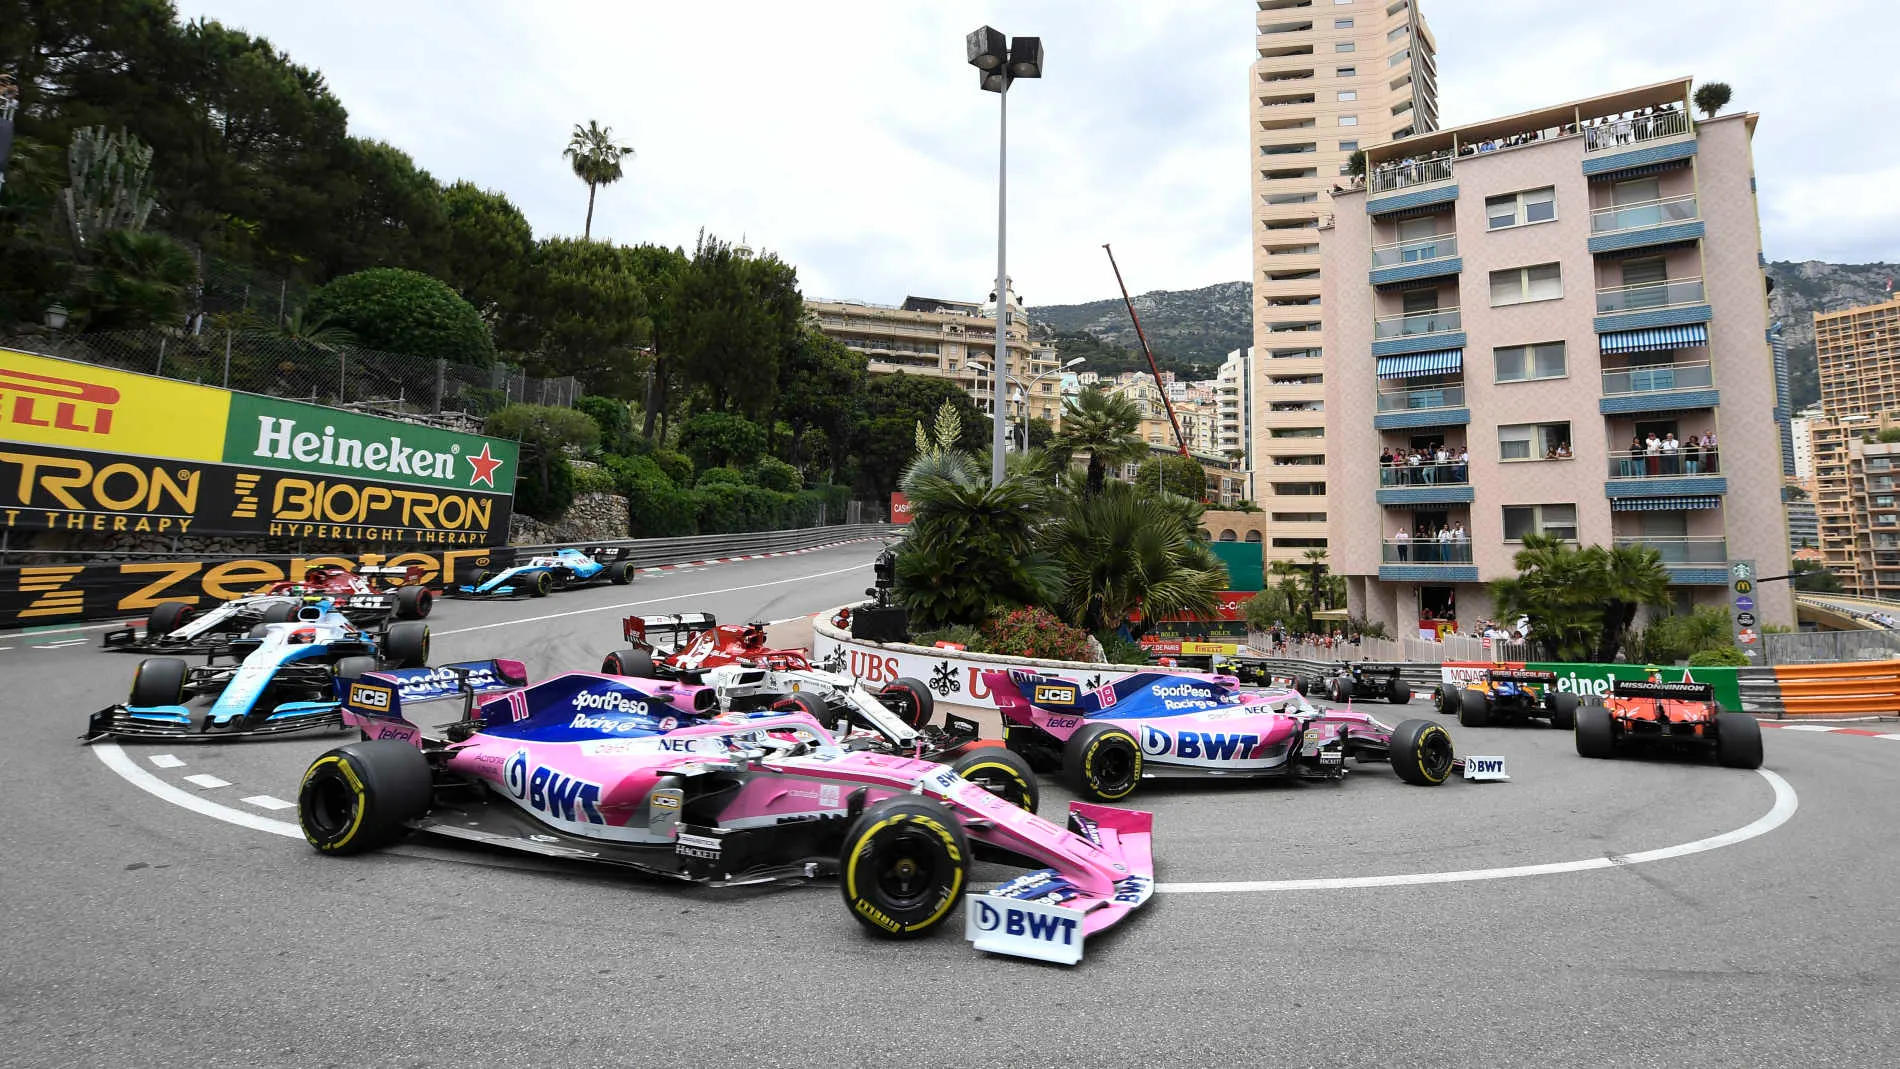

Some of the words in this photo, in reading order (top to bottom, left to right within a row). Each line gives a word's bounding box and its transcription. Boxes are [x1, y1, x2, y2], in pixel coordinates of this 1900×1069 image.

[253, 415, 456, 480] Heineken
[271, 478, 493, 530] BIOPTRON
[45, 512, 193, 533] THERAPY
[269, 523, 404, 541] HYPERLIGHT
[416, 530, 488, 544] THERAPY
[850, 650, 899, 684] UBS
[353, 689, 387, 707] JCB
[1038, 690, 1072, 701] JCB
[1096, 685, 1116, 709] 18
[1151, 684, 1211, 699] SportPesa
[507, 691, 529, 722] 11
[571, 690, 649, 716] SportPesa
[1164, 699, 1206, 709] Racing
[1244, 705, 1269, 714] NEC
[568, 713, 620, 733] Racing
[1046, 717, 1078, 728] telcel
[378, 727, 416, 742] telcel
[658, 739, 698, 753] NEC
[1176, 731, 1259, 761] BWT
[1477, 760, 1503, 773] BWT
[529, 765, 605, 825] BWT
[1114, 874, 1151, 903] BWT
[1006, 908, 1078, 946] BWT
